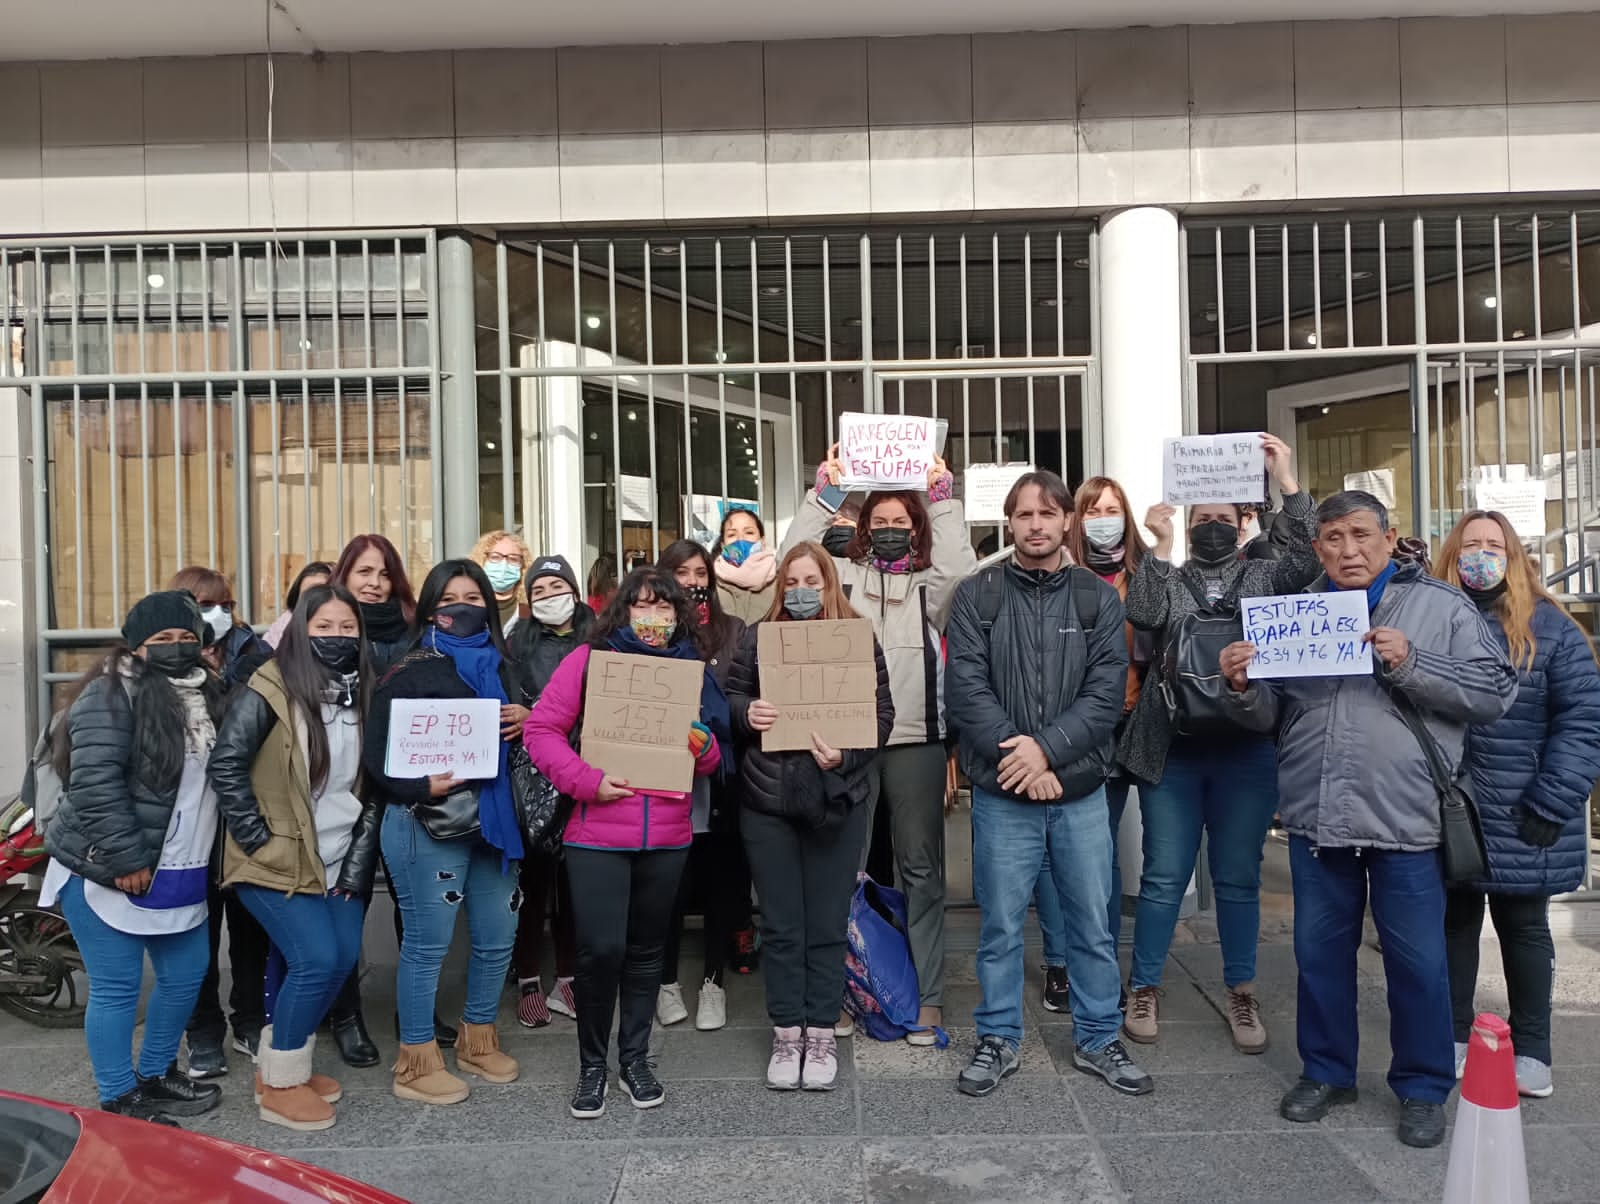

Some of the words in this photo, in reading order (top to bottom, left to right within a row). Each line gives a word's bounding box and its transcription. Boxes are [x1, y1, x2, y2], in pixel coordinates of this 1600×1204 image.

[848, 421, 928, 447] ARREGLEN
[875, 443, 904, 459] LAS
[851, 459, 928, 479] ESTUFAS!
[1247, 598, 1329, 626] ESTUFAS
[1311, 619, 1332, 637] LA
[1336, 616, 1360, 632] ESC
[778, 622, 852, 665] EES
[1308, 643, 1328, 659] 76
[601, 660, 673, 700] EES
[410, 713, 439, 736] EP
[445, 712, 473, 737] 78
[612, 703, 668, 736] 157
[408, 752, 455, 767] ESTUFAS
